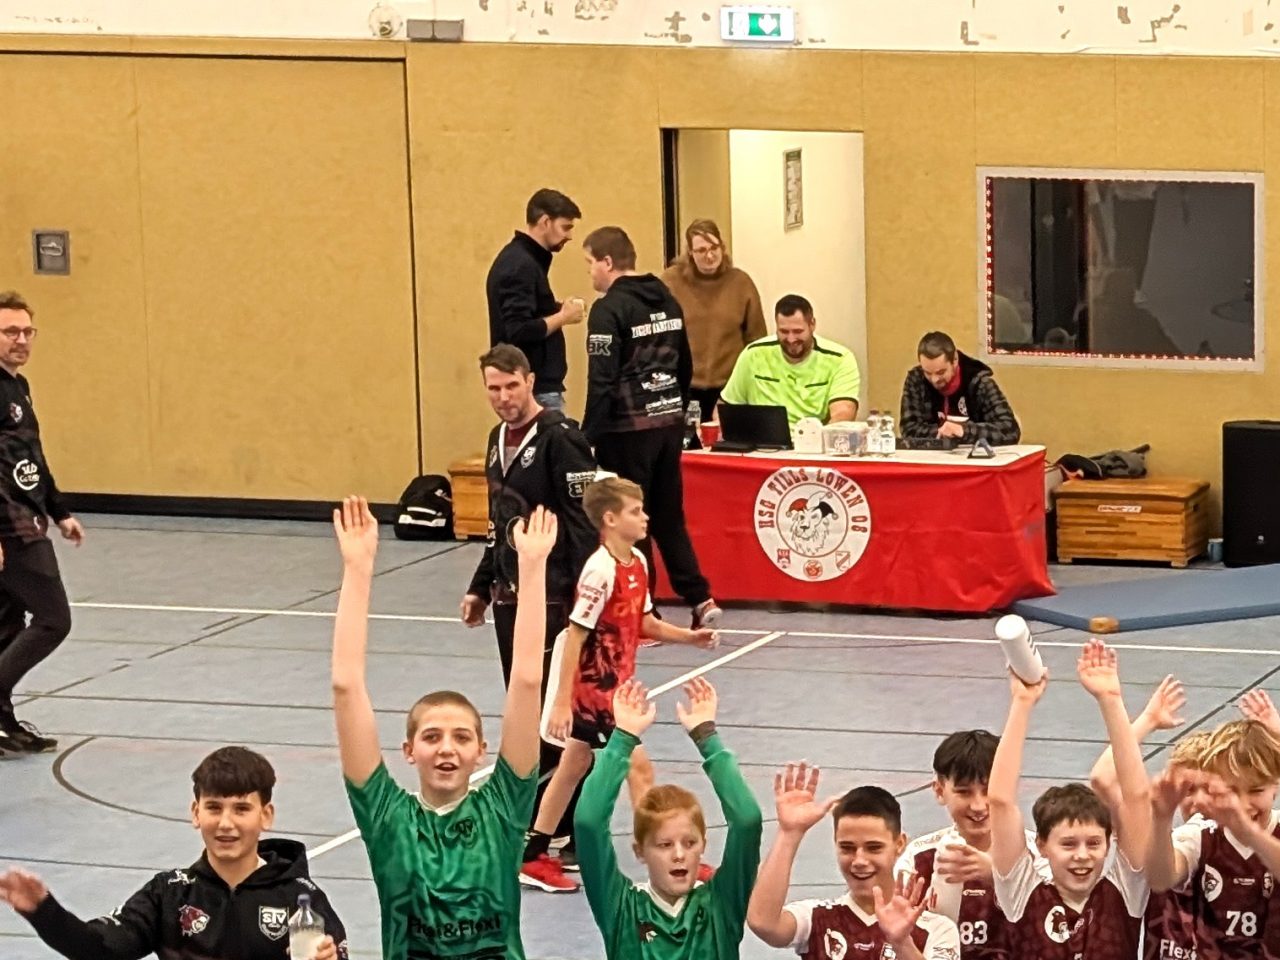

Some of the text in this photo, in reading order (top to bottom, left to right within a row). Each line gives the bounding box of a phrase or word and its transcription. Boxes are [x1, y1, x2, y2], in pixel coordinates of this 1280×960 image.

[767, 468, 809, 496] TILLS
[851, 515, 868, 533] 08
[959, 920, 988, 945] 83
[1225, 910, 1257, 937] 78
[1160, 938, 1197, 960] Flexi
